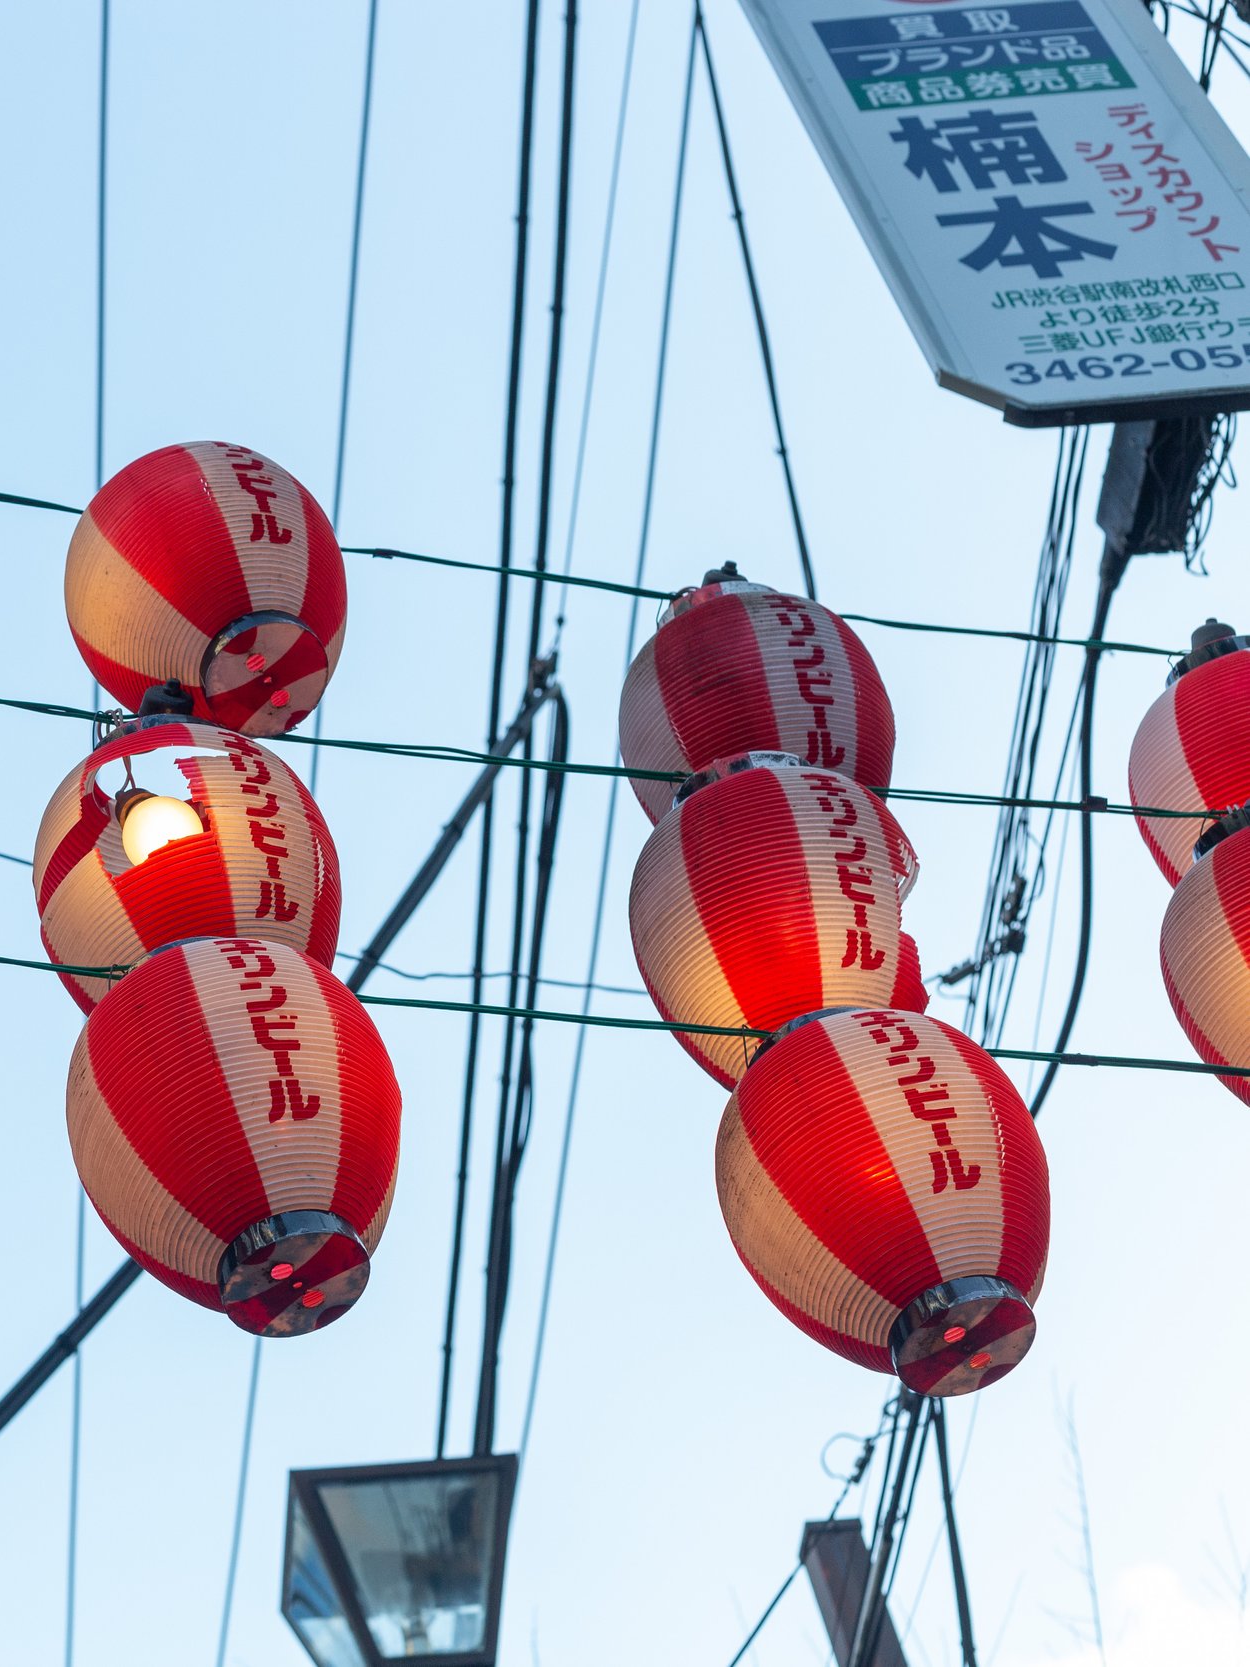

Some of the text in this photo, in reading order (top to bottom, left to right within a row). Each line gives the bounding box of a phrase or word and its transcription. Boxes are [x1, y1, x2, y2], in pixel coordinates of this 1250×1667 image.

[857, 34, 1092, 76] ブランド品
[889, 9, 1020, 41] 買取
[861, 63, 1121, 107] 商品券売買
[889, 108, 1118, 280] 楠本
[1074, 140, 1158, 232] ショップ
[1107, 103, 1241, 262] ディスカウント
[990, 271, 1246, 310] JR渋谷駅南改札西口
[1039, 296, 1221, 329] より徒歩2分
[1004, 343, 1250, 386] 3462-05
[213, 441, 293, 544] リンビール
[762, 594, 846, 768] キリンビール
[217, 731, 299, 922] キリンビール
[800, 773, 886, 971] キリンビール
[213, 938, 321, 1124] キリンビール
[851, 1010, 982, 1194] キリンビール
